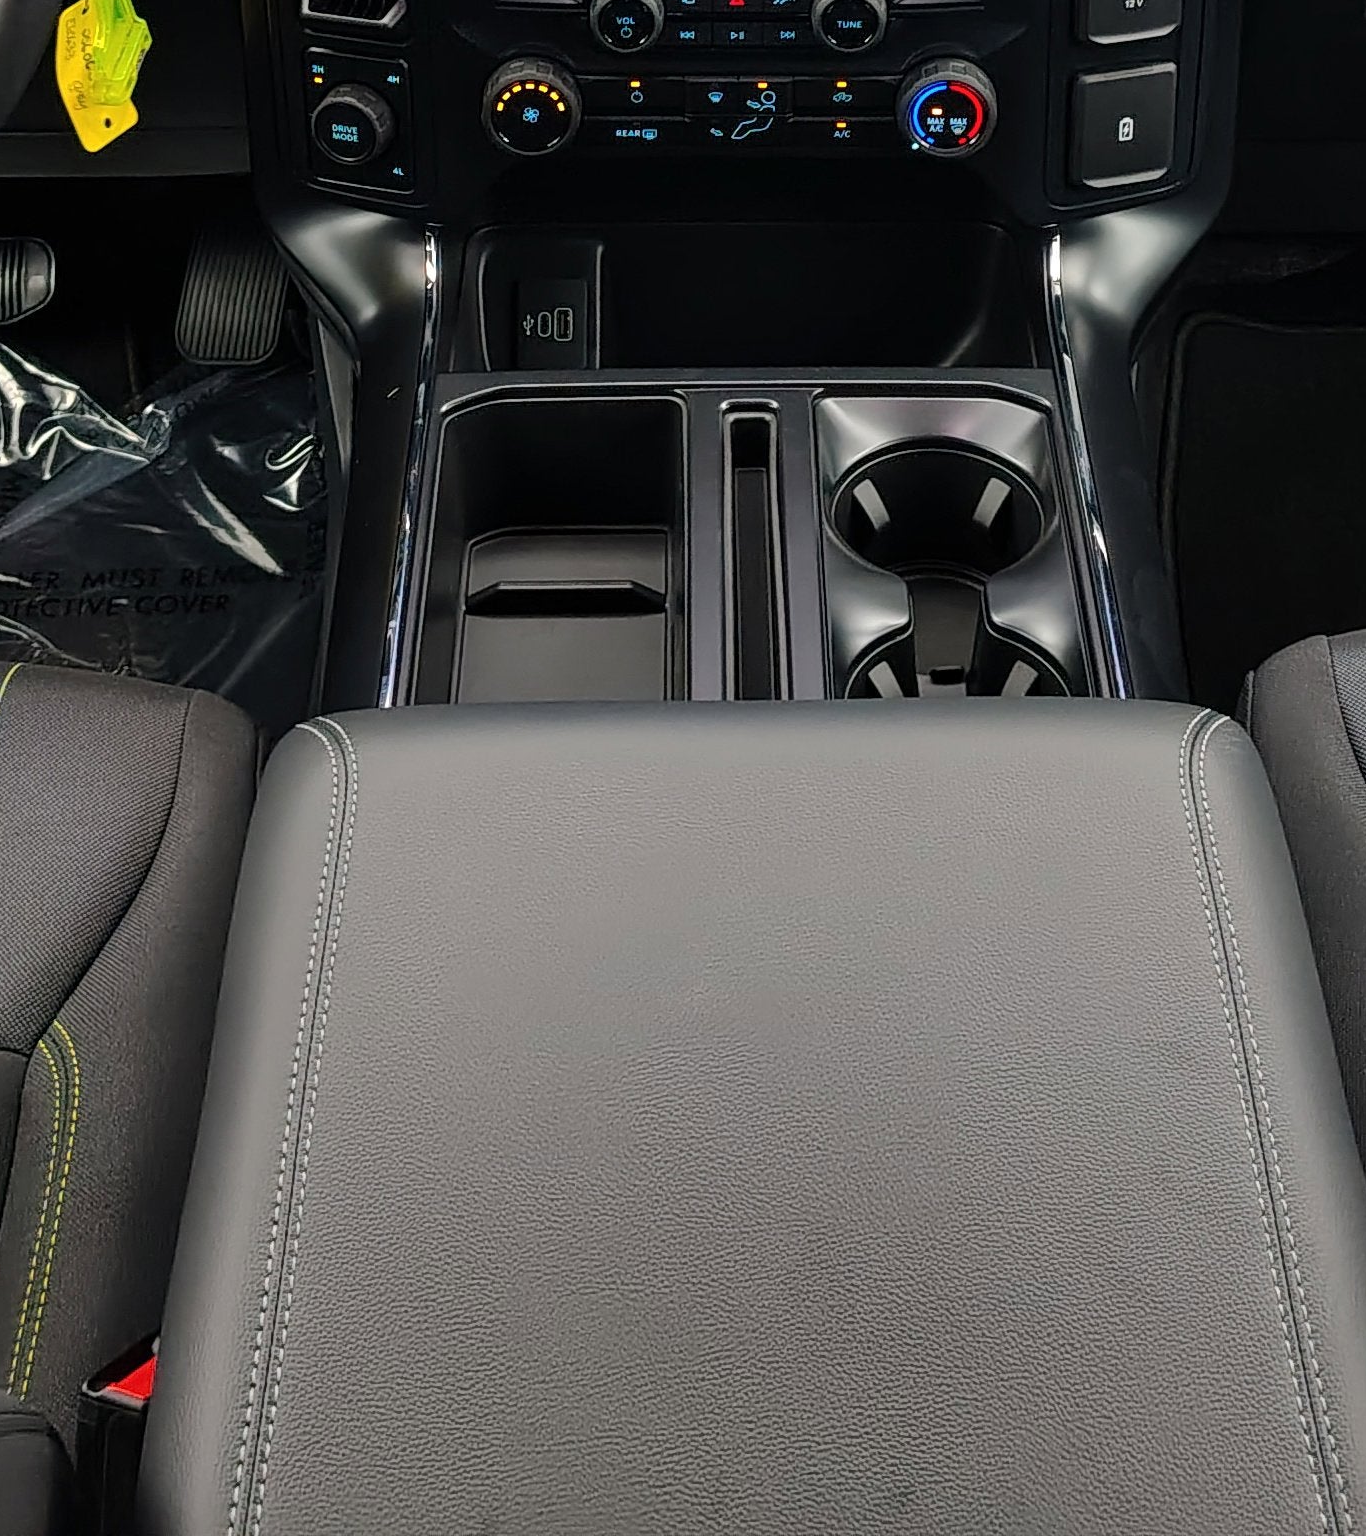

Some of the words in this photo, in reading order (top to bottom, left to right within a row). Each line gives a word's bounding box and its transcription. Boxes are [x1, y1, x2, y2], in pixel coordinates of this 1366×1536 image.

[616, 16, 635, 25] VOL
[837, 20, 863, 29] TUNE
[386, 75, 400, 84] 4H
[927, 117, 945, 125] MAX
[949, 117, 967, 125] MAX
[332, 123, 358, 135] DRIVE
[616, 129, 640, 137] REAR
[929, 124, 944, 133] A/C
[332, 132, 359, 142] MODE
[833, 130, 851, 138] A/C
[392, 167, 405, 176] 4L
[81, 567, 164, 590] MUST
[134, 593, 229, 615] COVER
